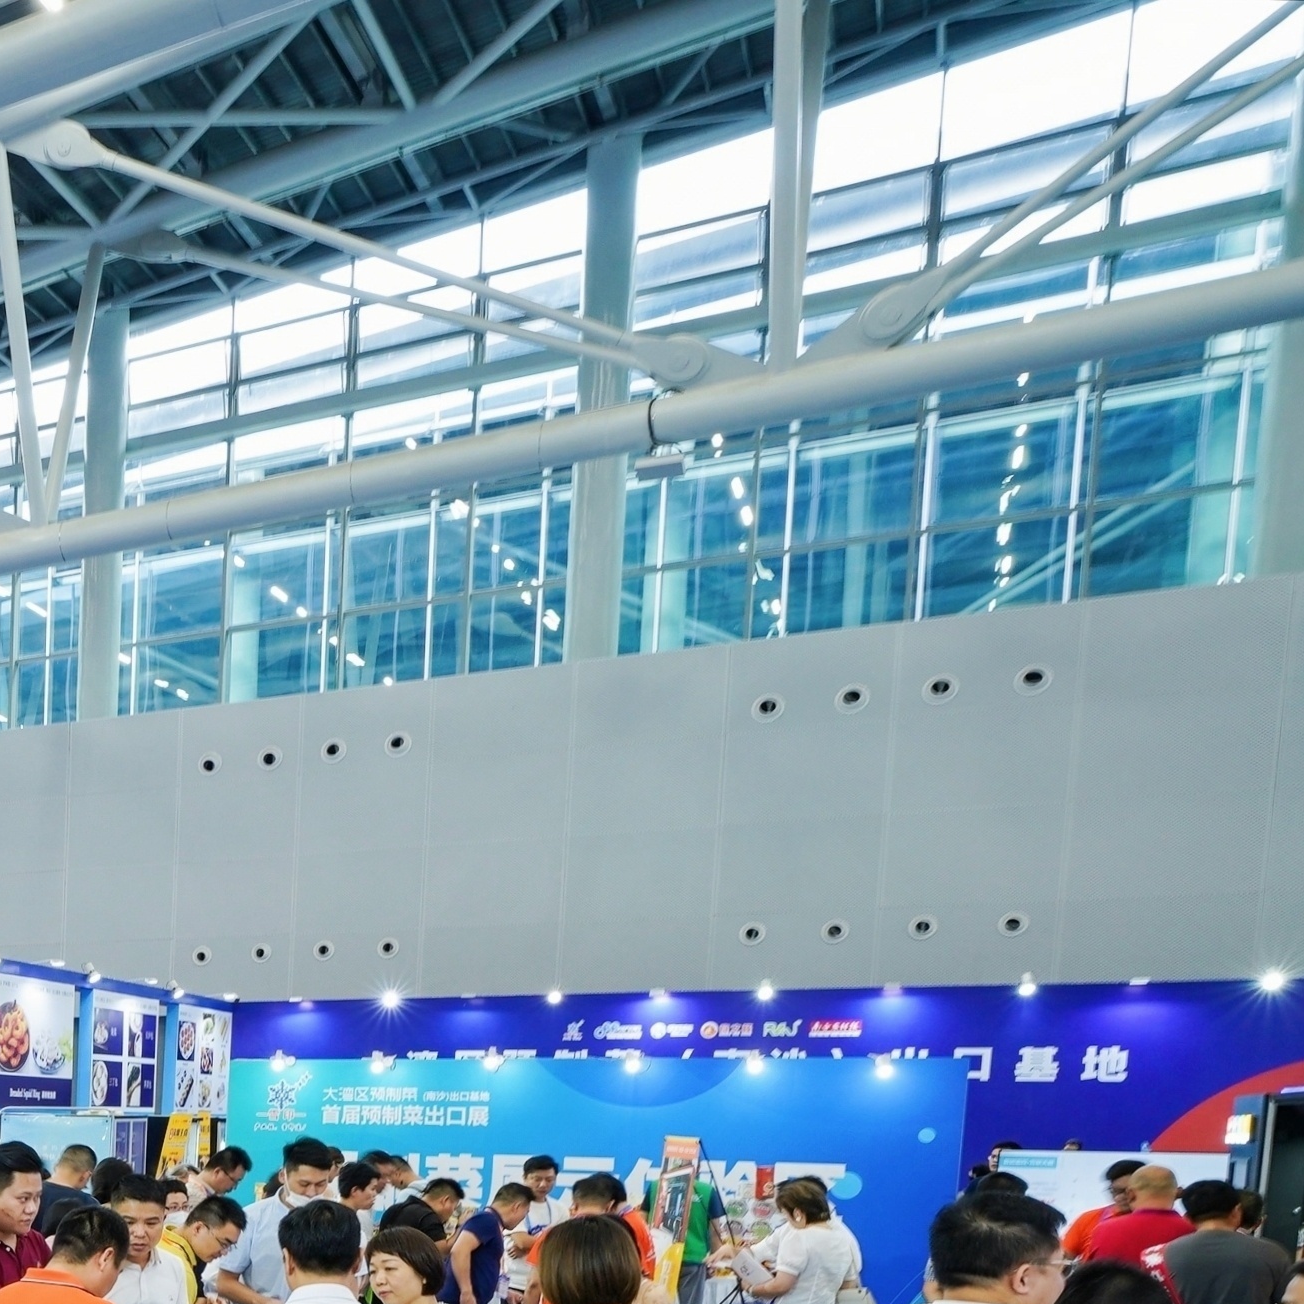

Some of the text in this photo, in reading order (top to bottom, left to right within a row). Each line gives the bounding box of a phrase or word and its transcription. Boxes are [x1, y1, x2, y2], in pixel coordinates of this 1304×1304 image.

[323, 1086, 418, 1102] 大湾区预制菜
[321, 1105, 490, 1127] 首届预制菜出口展
